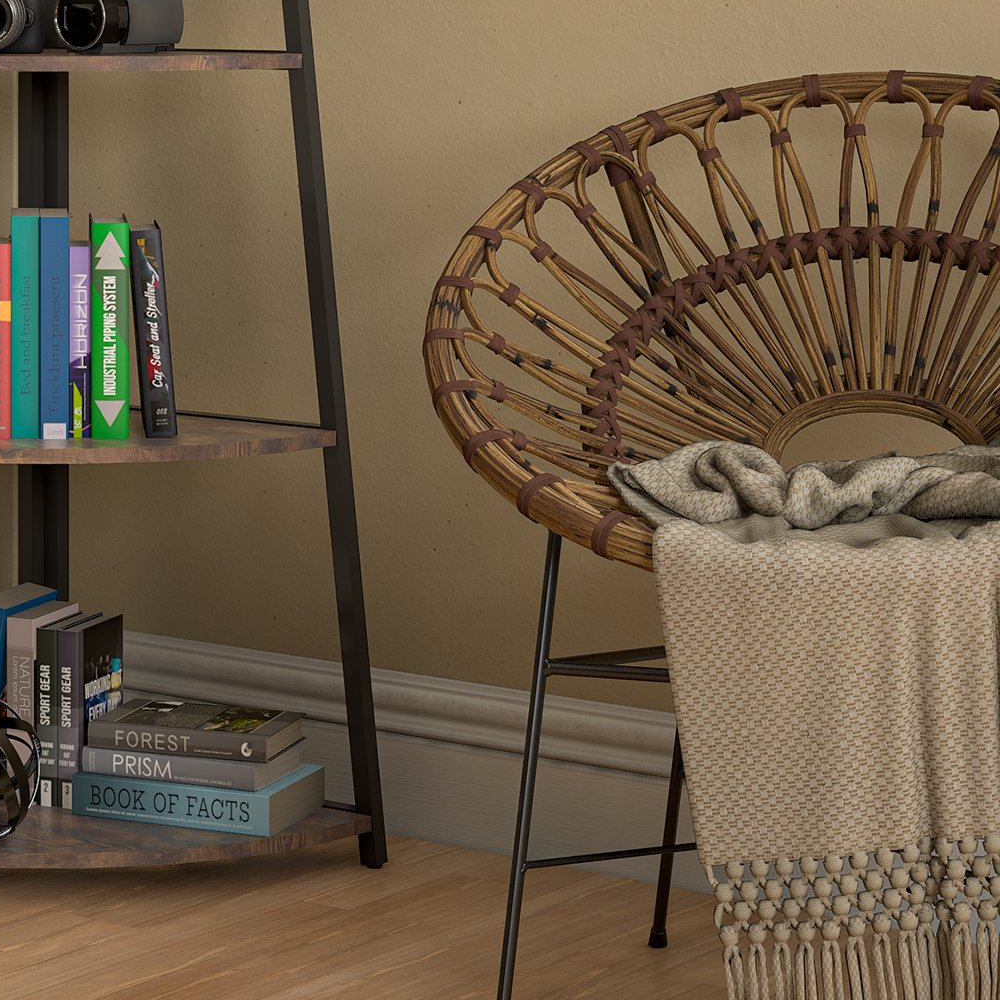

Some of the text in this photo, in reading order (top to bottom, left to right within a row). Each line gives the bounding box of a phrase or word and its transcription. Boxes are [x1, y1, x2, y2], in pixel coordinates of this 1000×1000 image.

[20, 275, 31, 336] breakfast
[72, 274, 88, 369] HORIZON
[20, 340, 31, 365] and
[103, 276, 116, 396] INDUSTRIAL PIPING SYSTEM
[144, 278, 165, 388] Car Seat and Stroller
[20, 370, 31, 394] Bed
[19, 656, 31, 718] NATURE
[40, 664, 50, 726] SPORT GEAR
[61, 666, 72, 728] SPORT GEAR
[88, 700, 107, 722] EVERY
[114, 730, 191, 752] FOREST
[112, 754, 172, 780] PRISM
[43, 782, 48, 792] 2
[64, 785, 70, 795] 3
[90, 784, 146, 811] BOOK
[154, 792, 179, 814] OF
[186, 795, 250, 823] FACTS
